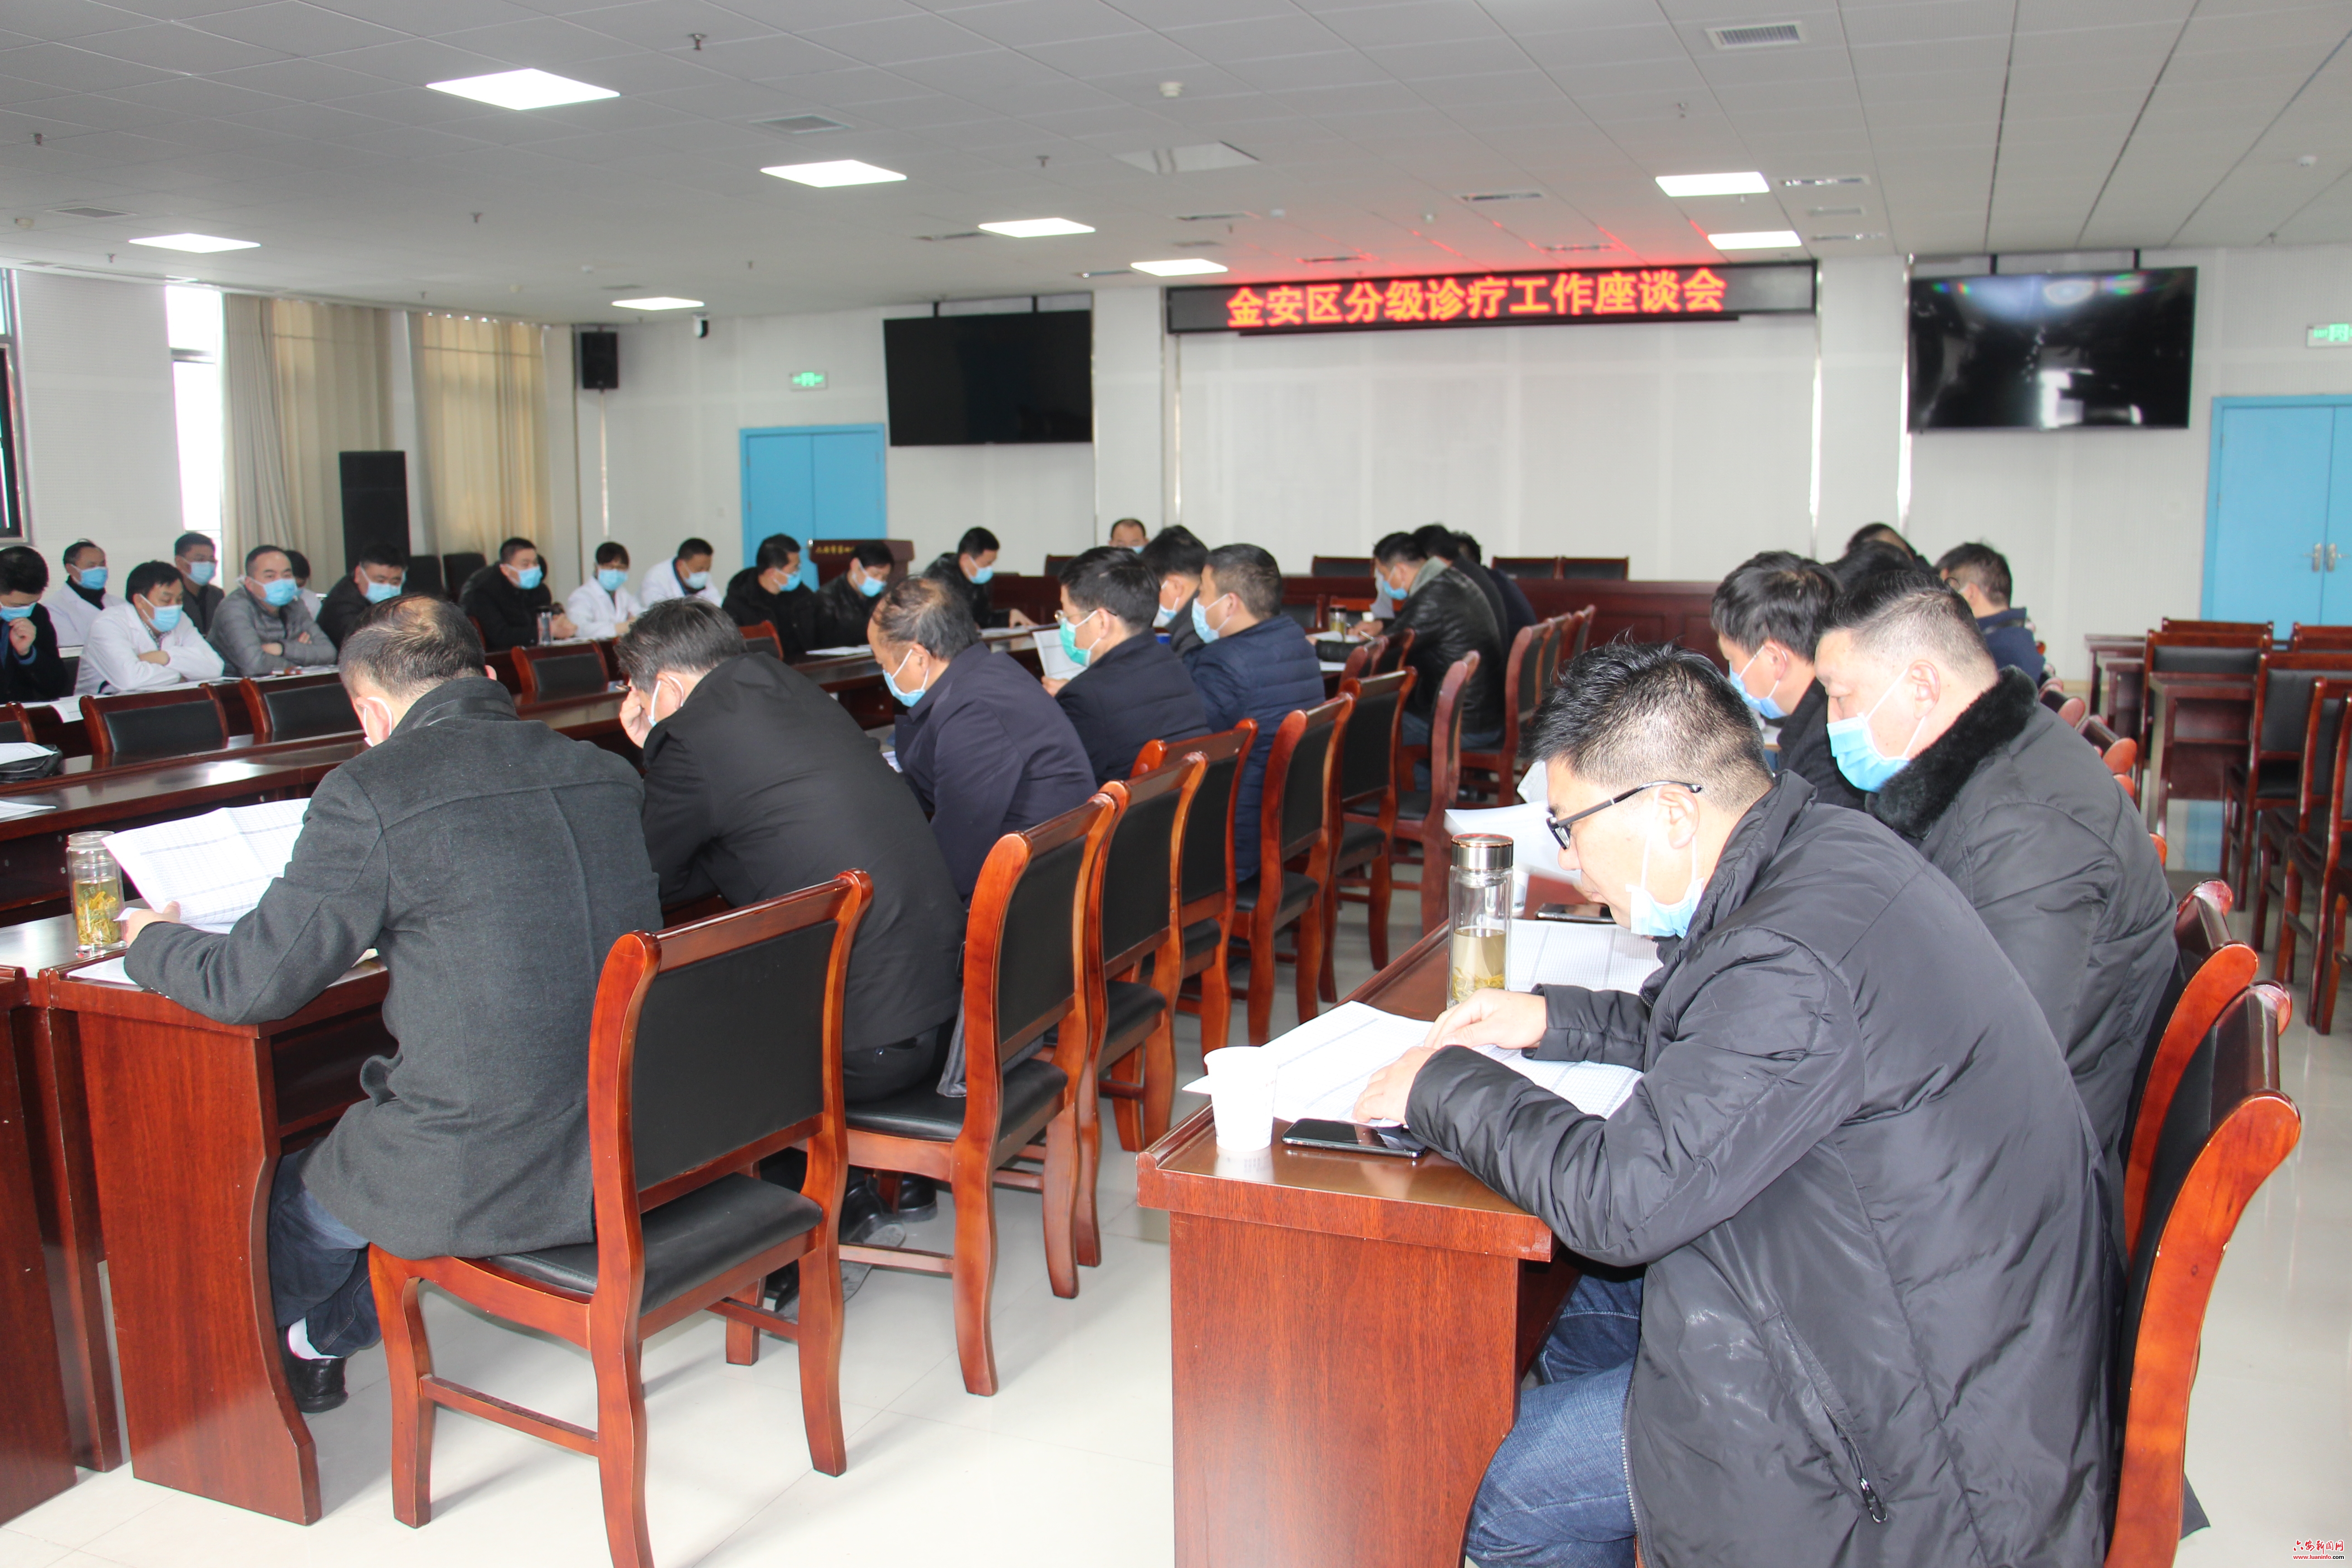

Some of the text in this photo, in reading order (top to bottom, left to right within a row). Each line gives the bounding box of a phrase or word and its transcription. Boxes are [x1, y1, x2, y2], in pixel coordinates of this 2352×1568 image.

[1227, 268, 1727, 328] 金安区分级诊疗工作座谈会
